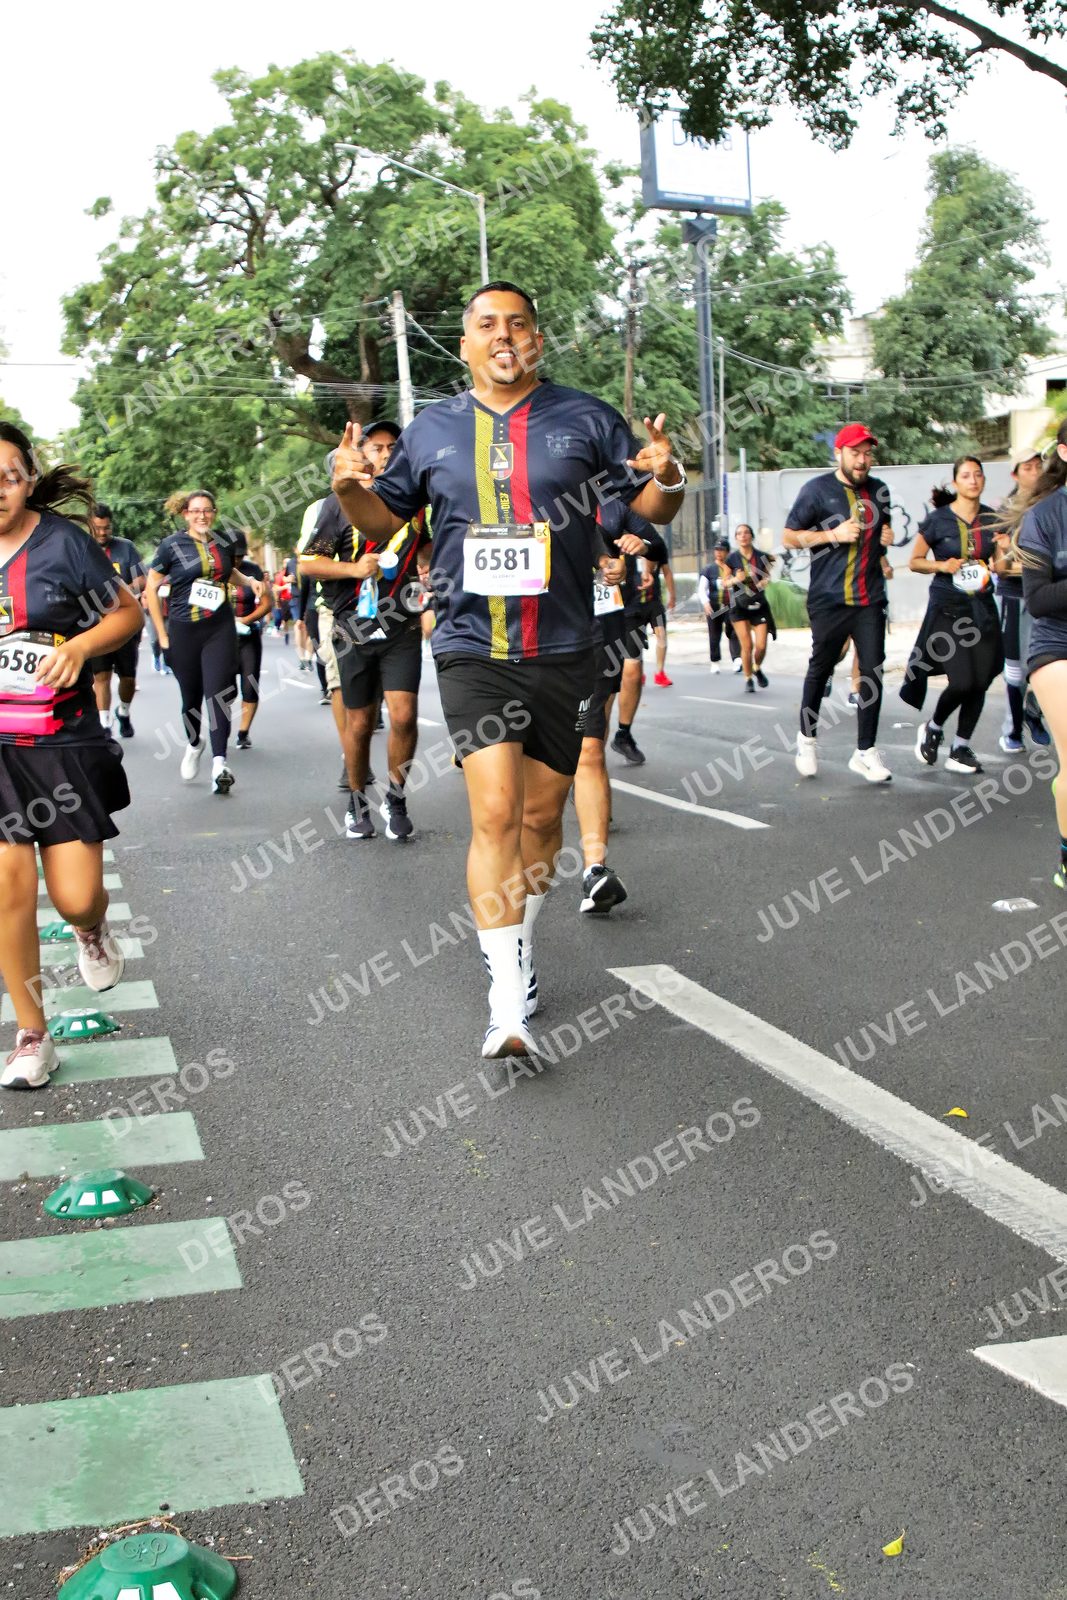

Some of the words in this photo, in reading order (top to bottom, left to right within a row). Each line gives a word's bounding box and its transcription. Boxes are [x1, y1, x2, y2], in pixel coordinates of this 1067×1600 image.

[475, 547, 530, 571] 6581
[961, 569, 979, 581] 550
[196, 587, 219, 601] 4261
[0, 649, 47, 674] 658
